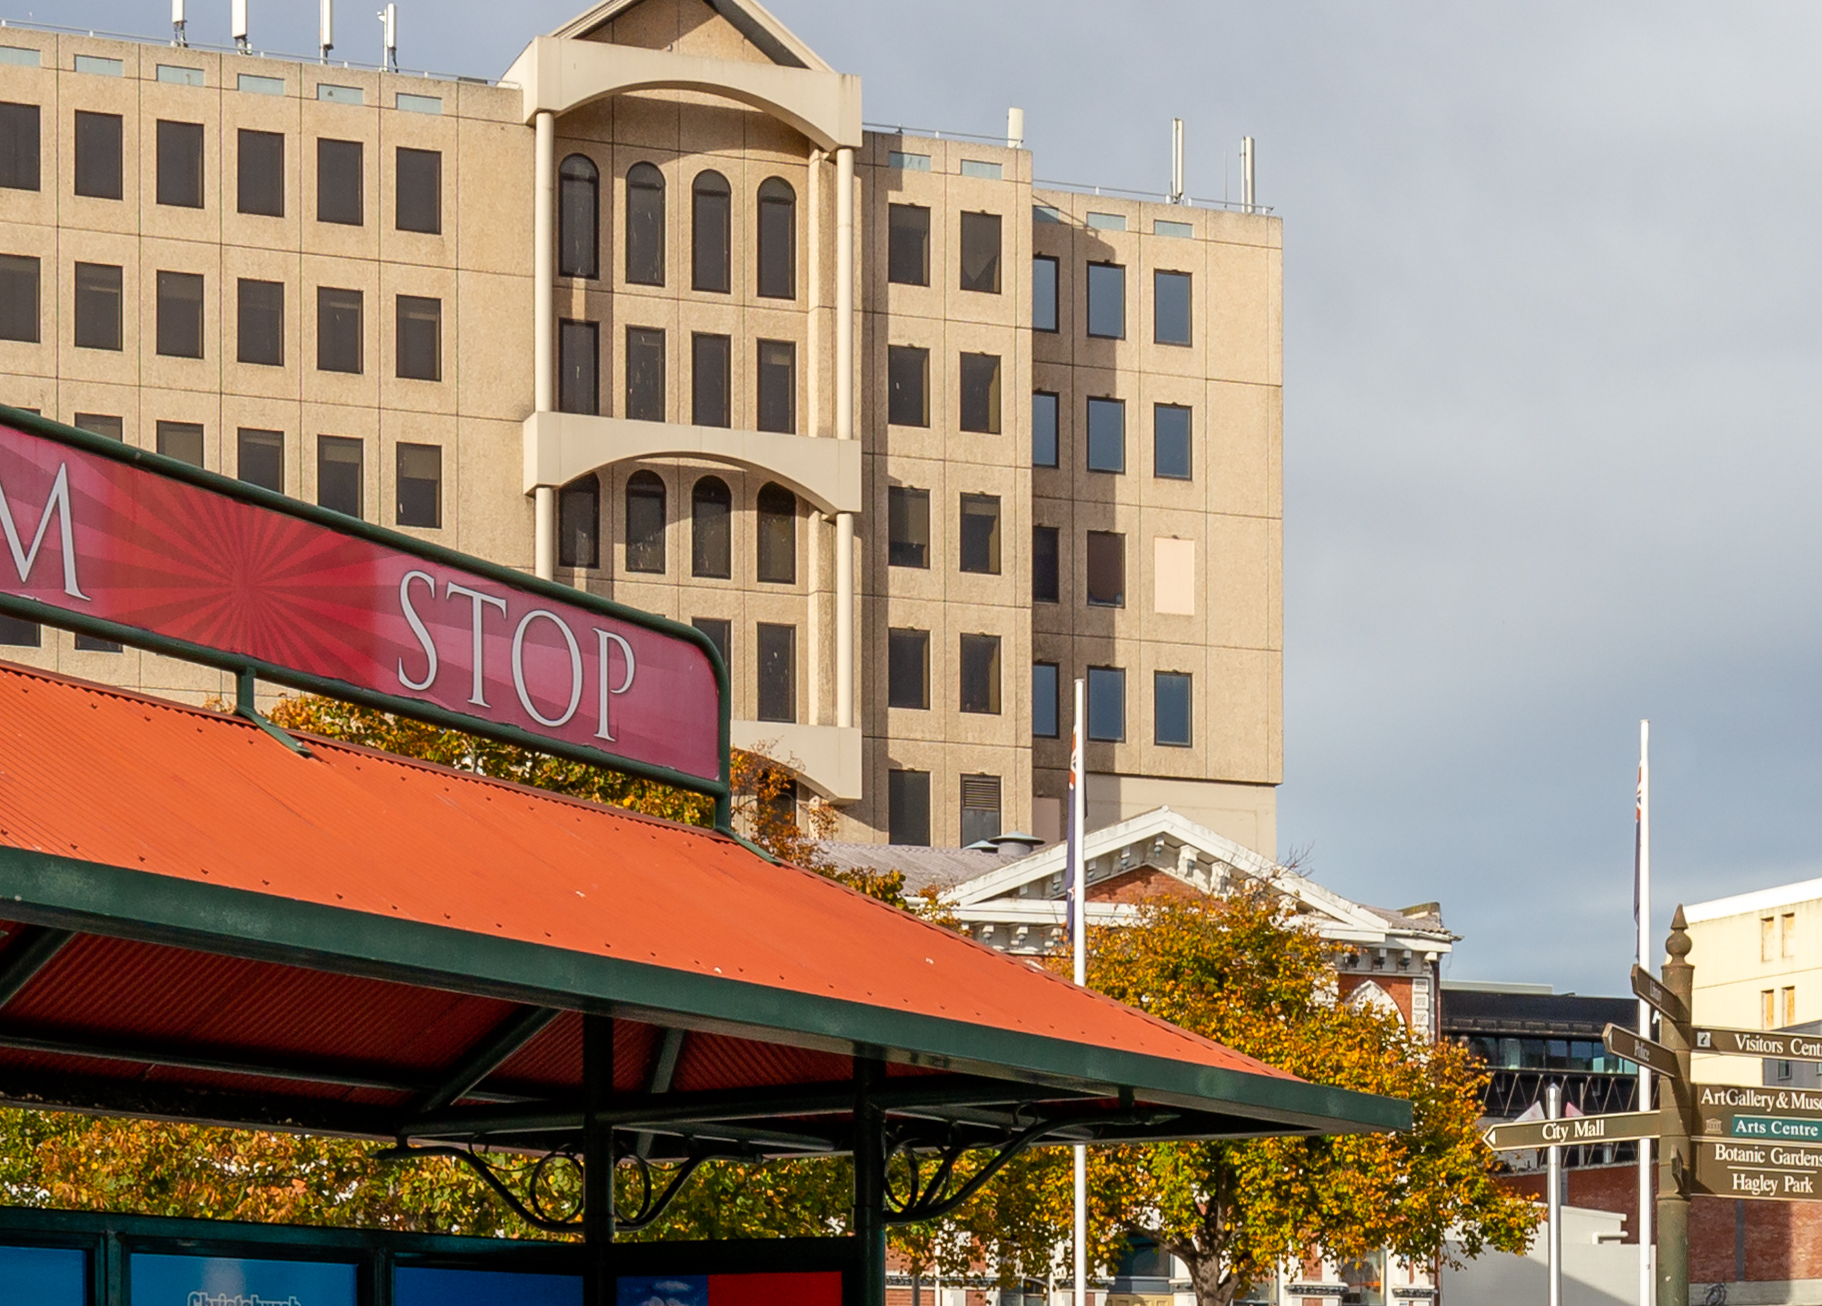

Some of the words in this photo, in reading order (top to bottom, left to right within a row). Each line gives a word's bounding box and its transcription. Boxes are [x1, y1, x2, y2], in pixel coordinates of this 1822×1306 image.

[398, 569, 636, 742] STOP
[1734, 1033, 1784, 1053] Visitors
[1790, 1038, 1822, 1057] Cent
[1775, 1091, 1789, 1109] &
[1541, 1122, 1569, 1143] City
[1574, 1119, 1605, 1138] Mall
[1735, 1119, 1767, 1134] Arts
[1770, 1121, 1819, 1137] Centre
[1714, 1143, 1766, 1163] Botanic
[1732, 1173, 1778, 1196] Hagley
[1784, 1175, 1814, 1194] Park
